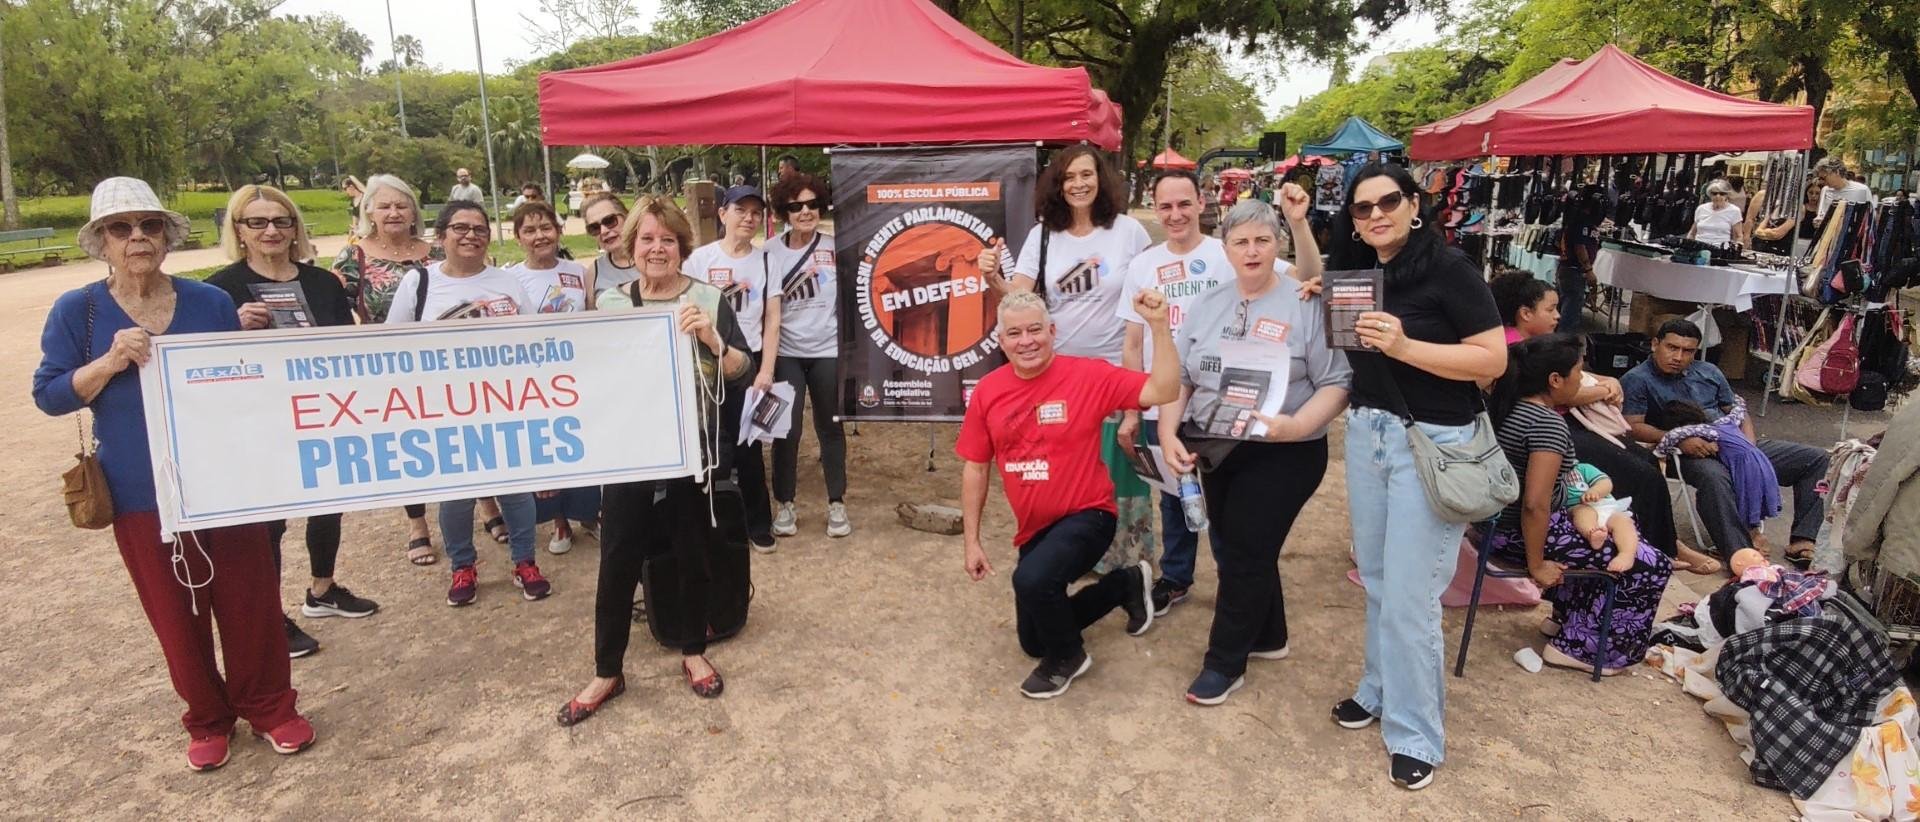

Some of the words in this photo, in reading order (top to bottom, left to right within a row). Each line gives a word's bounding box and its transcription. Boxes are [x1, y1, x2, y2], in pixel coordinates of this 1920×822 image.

[877, 188, 902, 199] 100%
[903, 187, 944, 198] ESCOLA
[945, 185, 990, 198] PÚBLICA
[865, 216, 904, 259] FRENTE
[903, 206, 995, 241] PARLAMENTAR
[881, 289, 912, 312] EM
[913, 275, 990, 306] DEFESA
[856, 261, 878, 330] INSTITUTO
[870, 329, 889, 349] DE
[884, 343, 951, 377] EDUCAÇÃO
[952, 349, 984, 371] GEN.
[285, 350, 414, 381] INSTITUTO
[419, 347, 449, 372] DE
[454, 337, 575, 369] EDUCAÇÃO
[290, 374, 580, 430] EX-ALUNAS
[883, 379, 933, 388] Assembleia
[884, 388, 931, 399] Legislativa
[297, 415, 585, 489] PRESENTES
